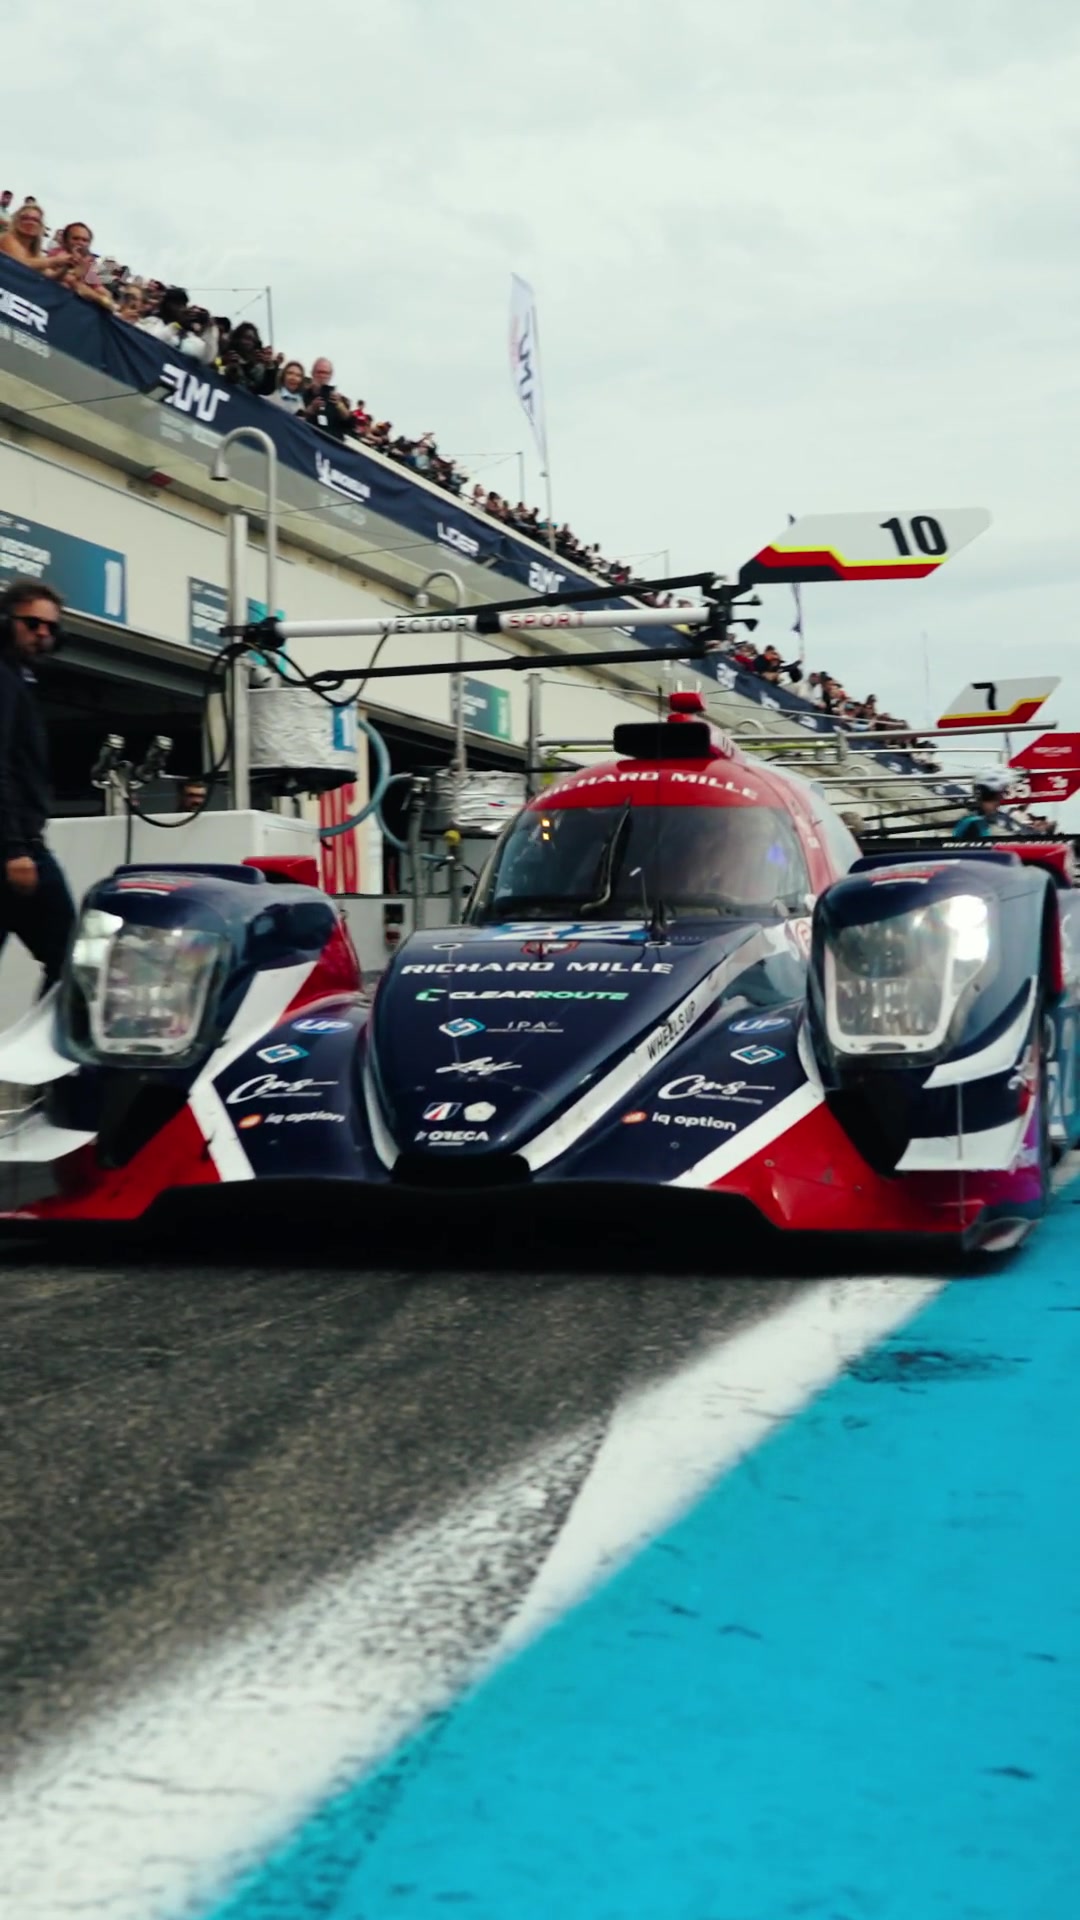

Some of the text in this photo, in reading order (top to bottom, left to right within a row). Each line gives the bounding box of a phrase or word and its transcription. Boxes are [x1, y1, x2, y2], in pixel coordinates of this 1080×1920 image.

[880, 515, 948, 556] 10
[378, 611, 585, 634] VECTOR SPORT
[972, 682, 997, 710] 7
[671, 772, 757, 800] MILLE
[402, 962, 674, 974] RICHARD MILLE
[449, 990, 630, 1000] CLEARROUTE
[734, 1018, 786, 1031] UP
[652, 1111, 737, 1131] iq option
